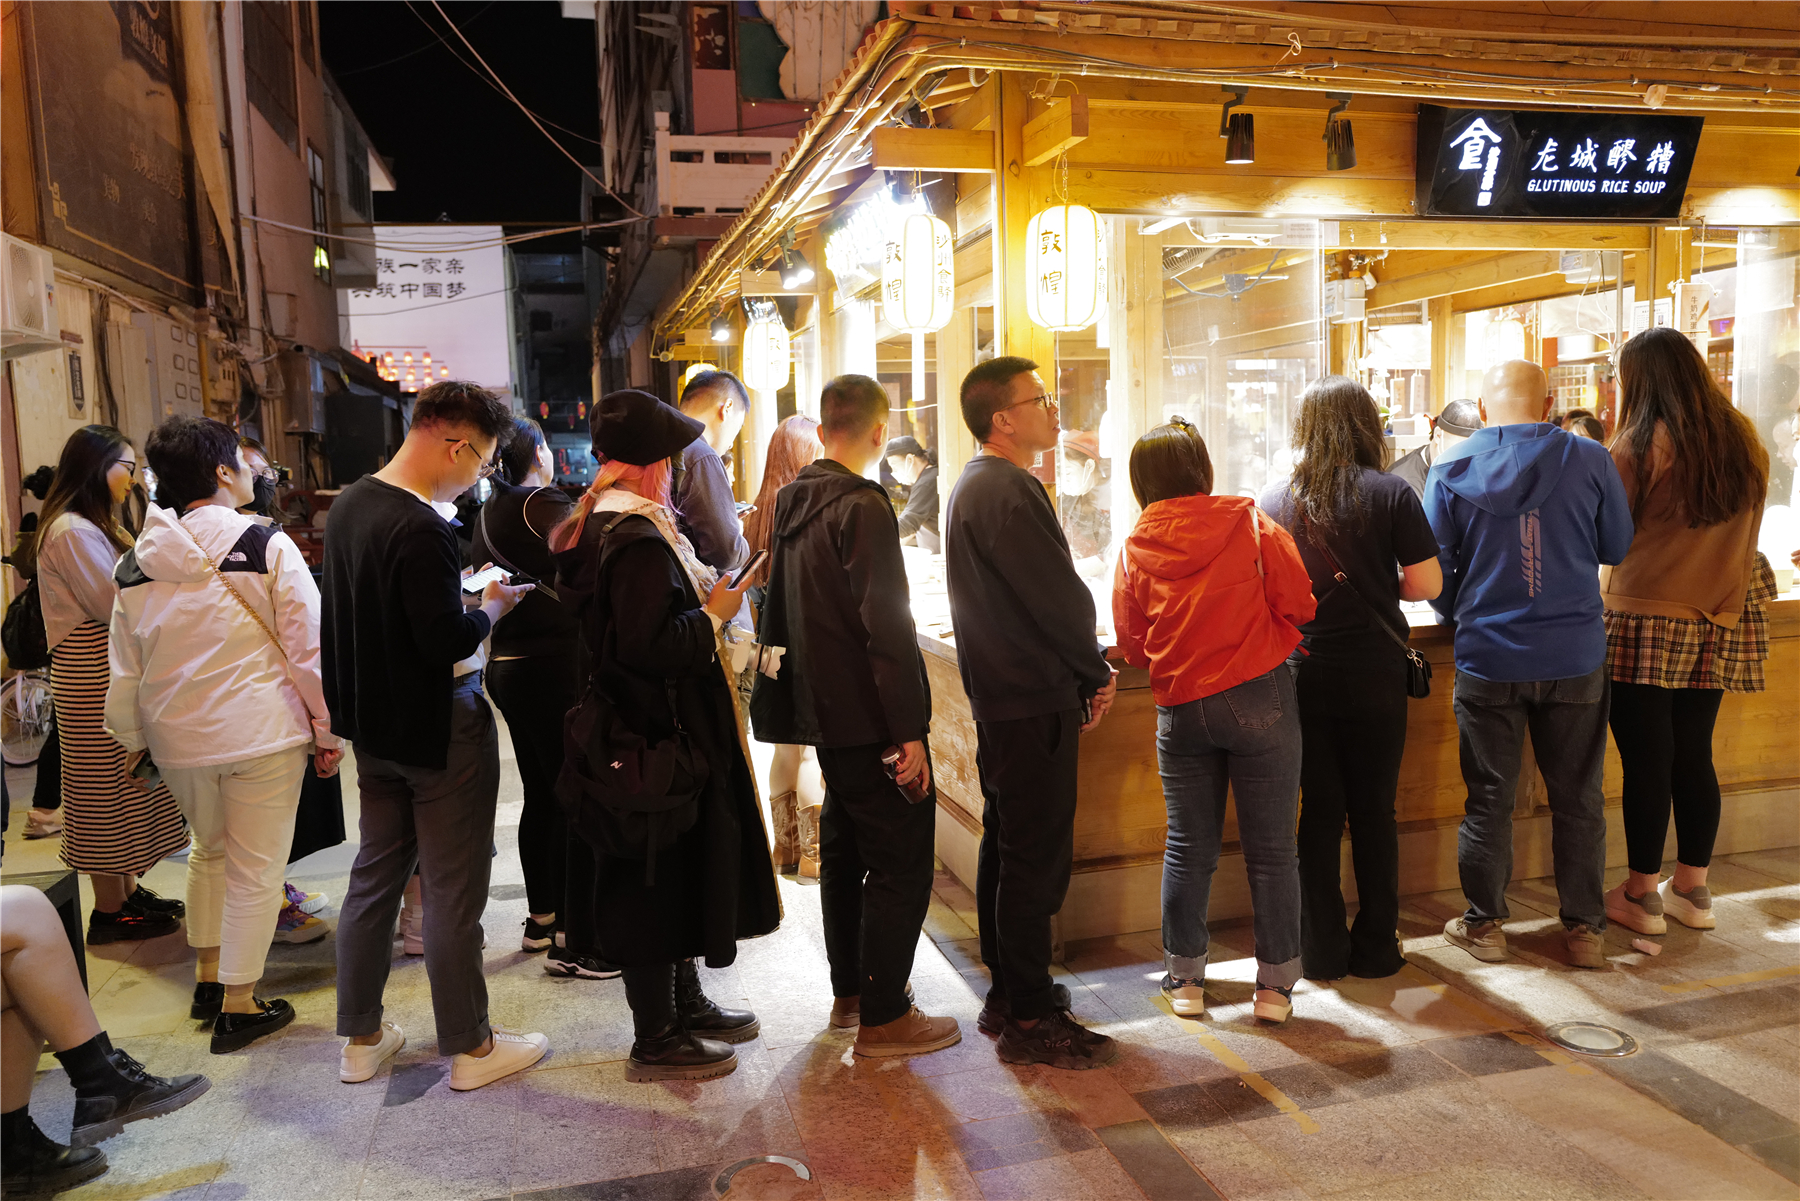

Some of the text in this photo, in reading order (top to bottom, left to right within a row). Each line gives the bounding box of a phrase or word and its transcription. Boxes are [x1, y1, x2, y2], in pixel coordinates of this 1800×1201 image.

[1527, 179, 1666, 194] GLUTINOUS RICE SOUP
[376, 257, 465, 275] 族一家亲
[884, 240, 903, 302] 敦煌
[936, 234, 952, 302] 沙州食驿
[1040, 229, 1063, 295] 敦煌
